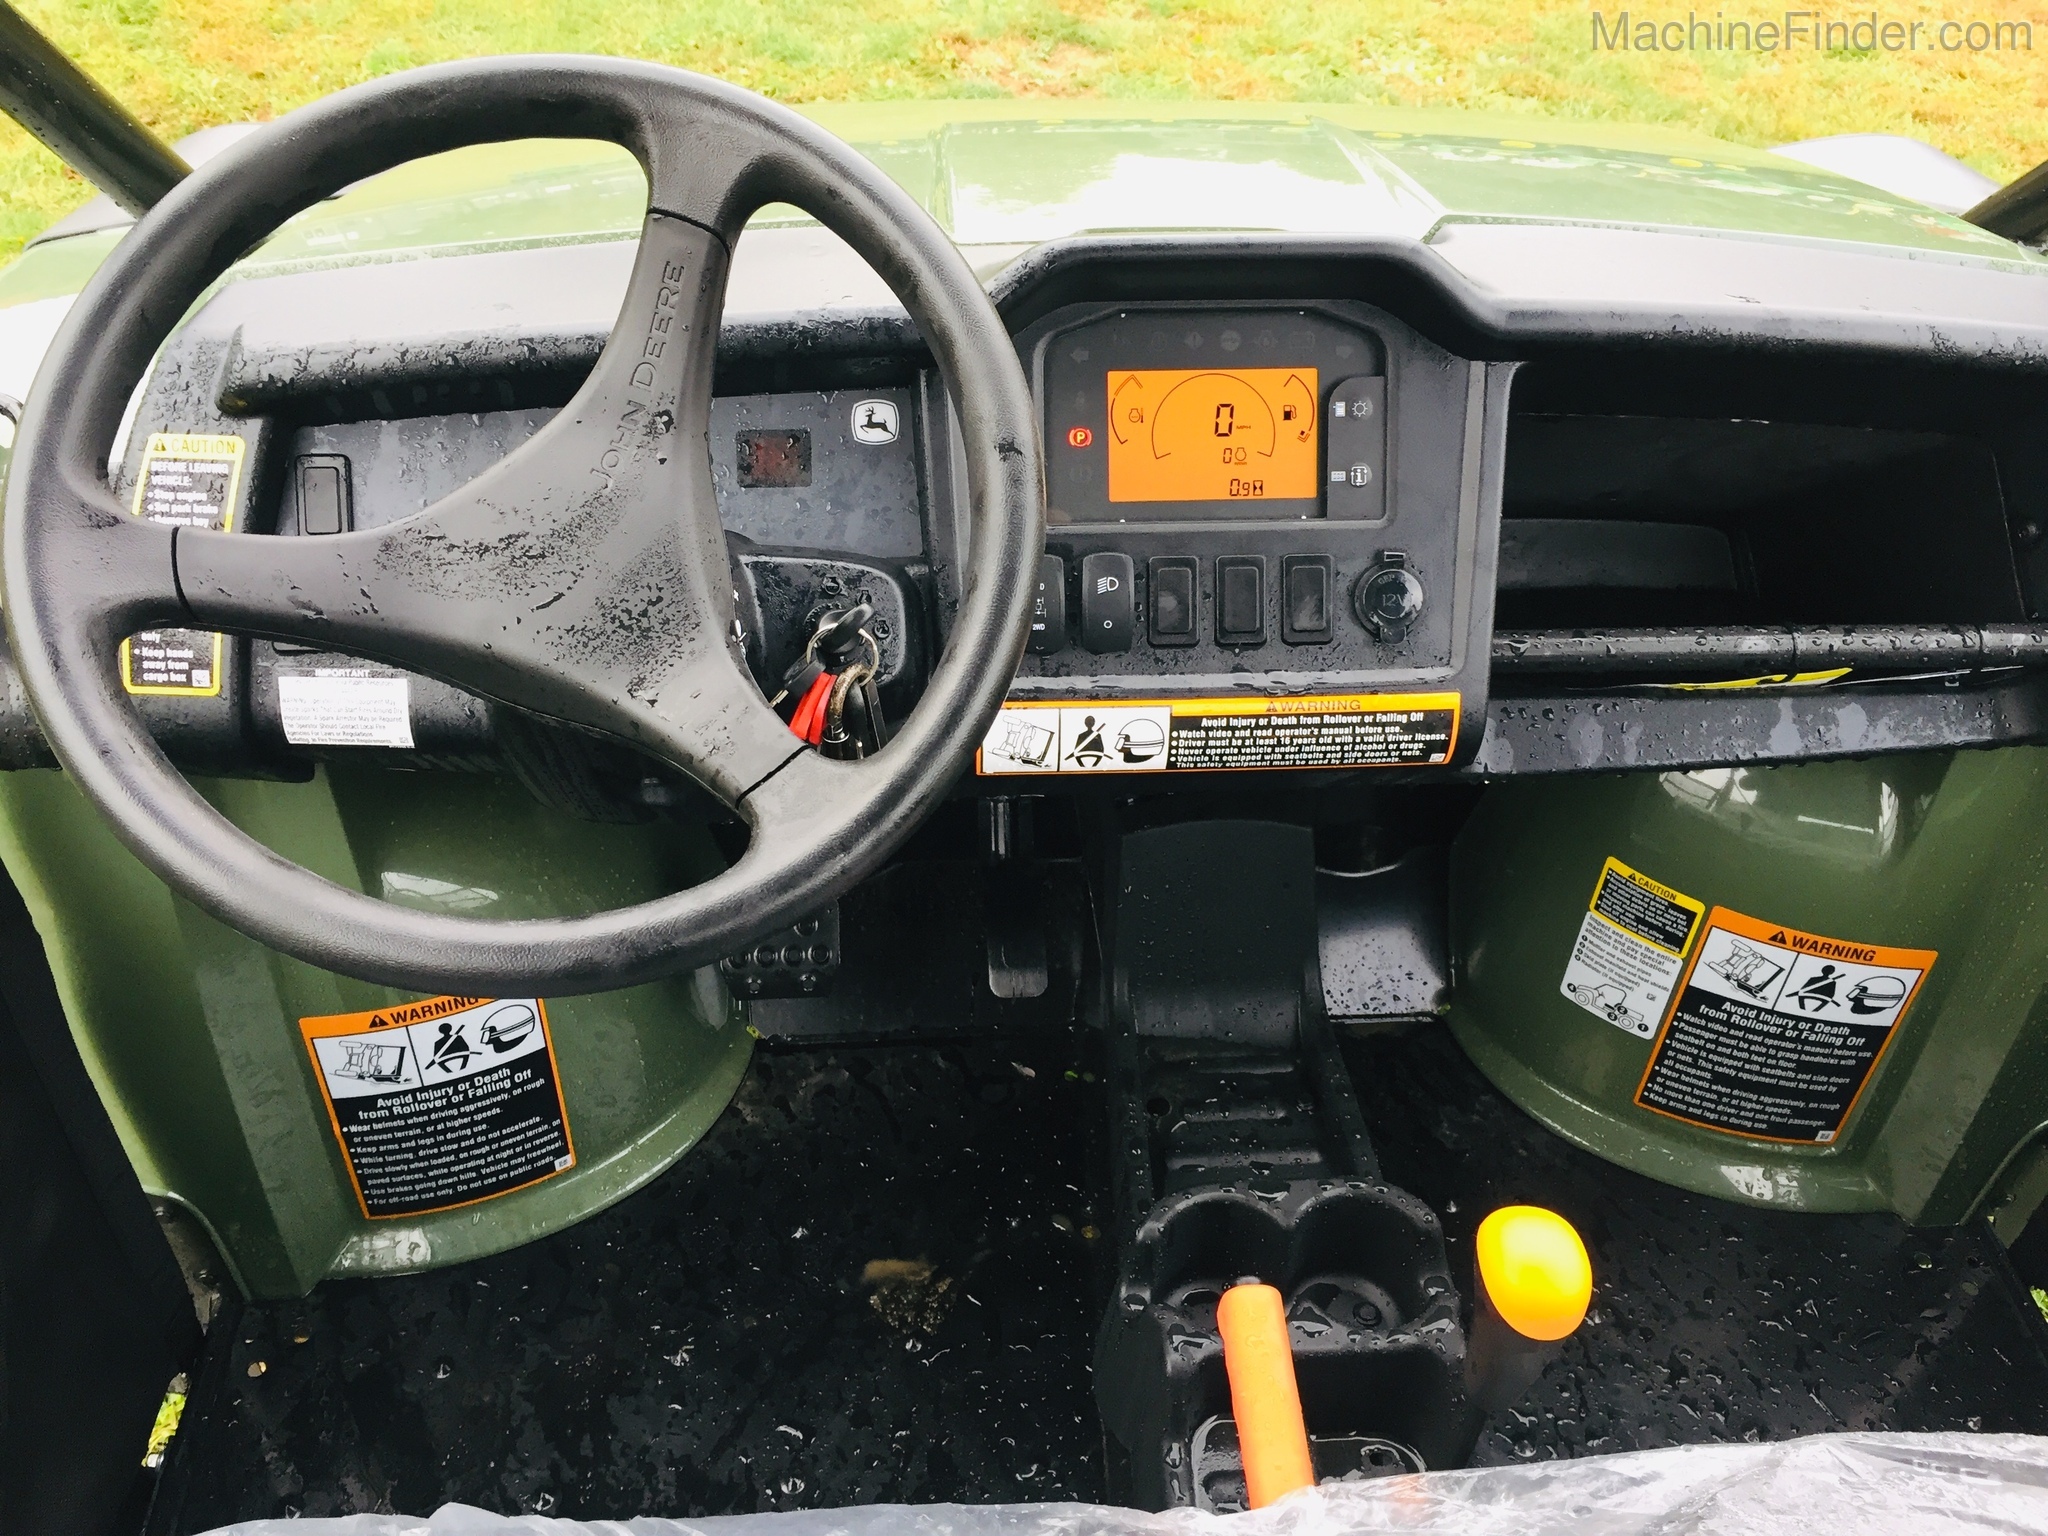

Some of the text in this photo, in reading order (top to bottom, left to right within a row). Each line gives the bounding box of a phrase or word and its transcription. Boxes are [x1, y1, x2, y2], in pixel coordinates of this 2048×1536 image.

[590, 260, 685, 489] JOHN DEERE
[1214, 403, 1234, 437] 0
[171, 439, 235, 454] CAUTION
[1223, 448, 1232, 464] 0
[142, 646, 194, 659] Keep hands
[167, 660, 189, 670] from
[315, 668, 370, 678] IMPORTANT
[170, 672, 187, 682] box
[1280, 700, 1361, 712] WARNING
[1201, 717, 1227, 727] Avoid
[1230, 717, 1256, 728] Injury
[1271, 715, 1297, 725] Death
[1300, 715, 1321, 724] from
[1323, 714, 1361, 724] Rollover
[1376, 712, 1407, 724] Falling
[1410, 712, 1424, 721] Off
[1179, 730, 1206, 738] Watch
[1208, 729, 1232, 738] video
[1234, 728, 1250, 737] and
[1253, 728, 1272, 736] read
[1275, 727, 1318, 738] operator's
[1321, 726, 1352, 735] manual
[1355, 725, 1382, 734] before
[1179, 739, 1206, 747] Driver
[1208, 738, 1229, 746] must
[1231, 738, 1242, 746] be
[1245, 737, 1253, 745] at
[1256, 737, 1277, 745] least
[1280, 736, 1290, 744] 16
[1292, 737, 1316, 746] years
[1319, 735, 1332, 743] old
[1334, 735, 1352, 743] with
[1363, 734, 1384, 742] valid
[1387, 733, 1412, 742] driver
[1415, 733, 1448, 741] license.
[1178, 747, 1203, 755] Never
[1206, 746, 1238, 756] operate
[1241, 745, 1272, 754] vehicle
[1274, 745, 1299, 753] under
[1301, 744, 1341, 752] influence
[1343, 743, 1351, 751] of
[1354, 742, 1386, 750] alcohol
[1399, 741, 1426, 750] drugs.
[1223, 753, 1262, 762] equipped
[1638, 878, 1677, 901] CAUTION
[1792, 935, 1876, 962] WARNING
[1699, 1004, 1866, 1048] from Rollover or Falling Off
[1721, 1001, 1850, 1036] Avoid Injury or Death
[1683, 1012, 1706, 1026] Watch
[1707, 1022, 1728, 1033] video
[1729, 1028, 1744, 1037] and
[1745, 1032, 1764, 1042] read
[1764, 1037, 1802, 1050] operator's
[1803, 1044, 1832, 1054] manual
[1833, 1047, 1857, 1056] before
[358, 1069, 532, 1120] from Rollover or Falling Off
[376, 1067, 511, 1108] Avoid Injury or Death
[348, 1077, 545, 1133] Wear helmets when driving aggressively, on rough
[363, 1133, 393, 1142] uneven
[394, 1128, 424, 1138] terrain,
[426, 1125, 435, 1133] or
[436, 1122, 445, 1130] at
[446, 1116, 472, 1128] higher
[473, 1107, 504, 1121] speeds.
[356, 1146, 377, 1154] Keep
[378, 1143, 400, 1151] arms
[401, 1139, 416, 1148] and
[417, 1137, 435, 1146] legs
[446, 1128, 471, 1140] during
[473, 1123, 490, 1133] use.
